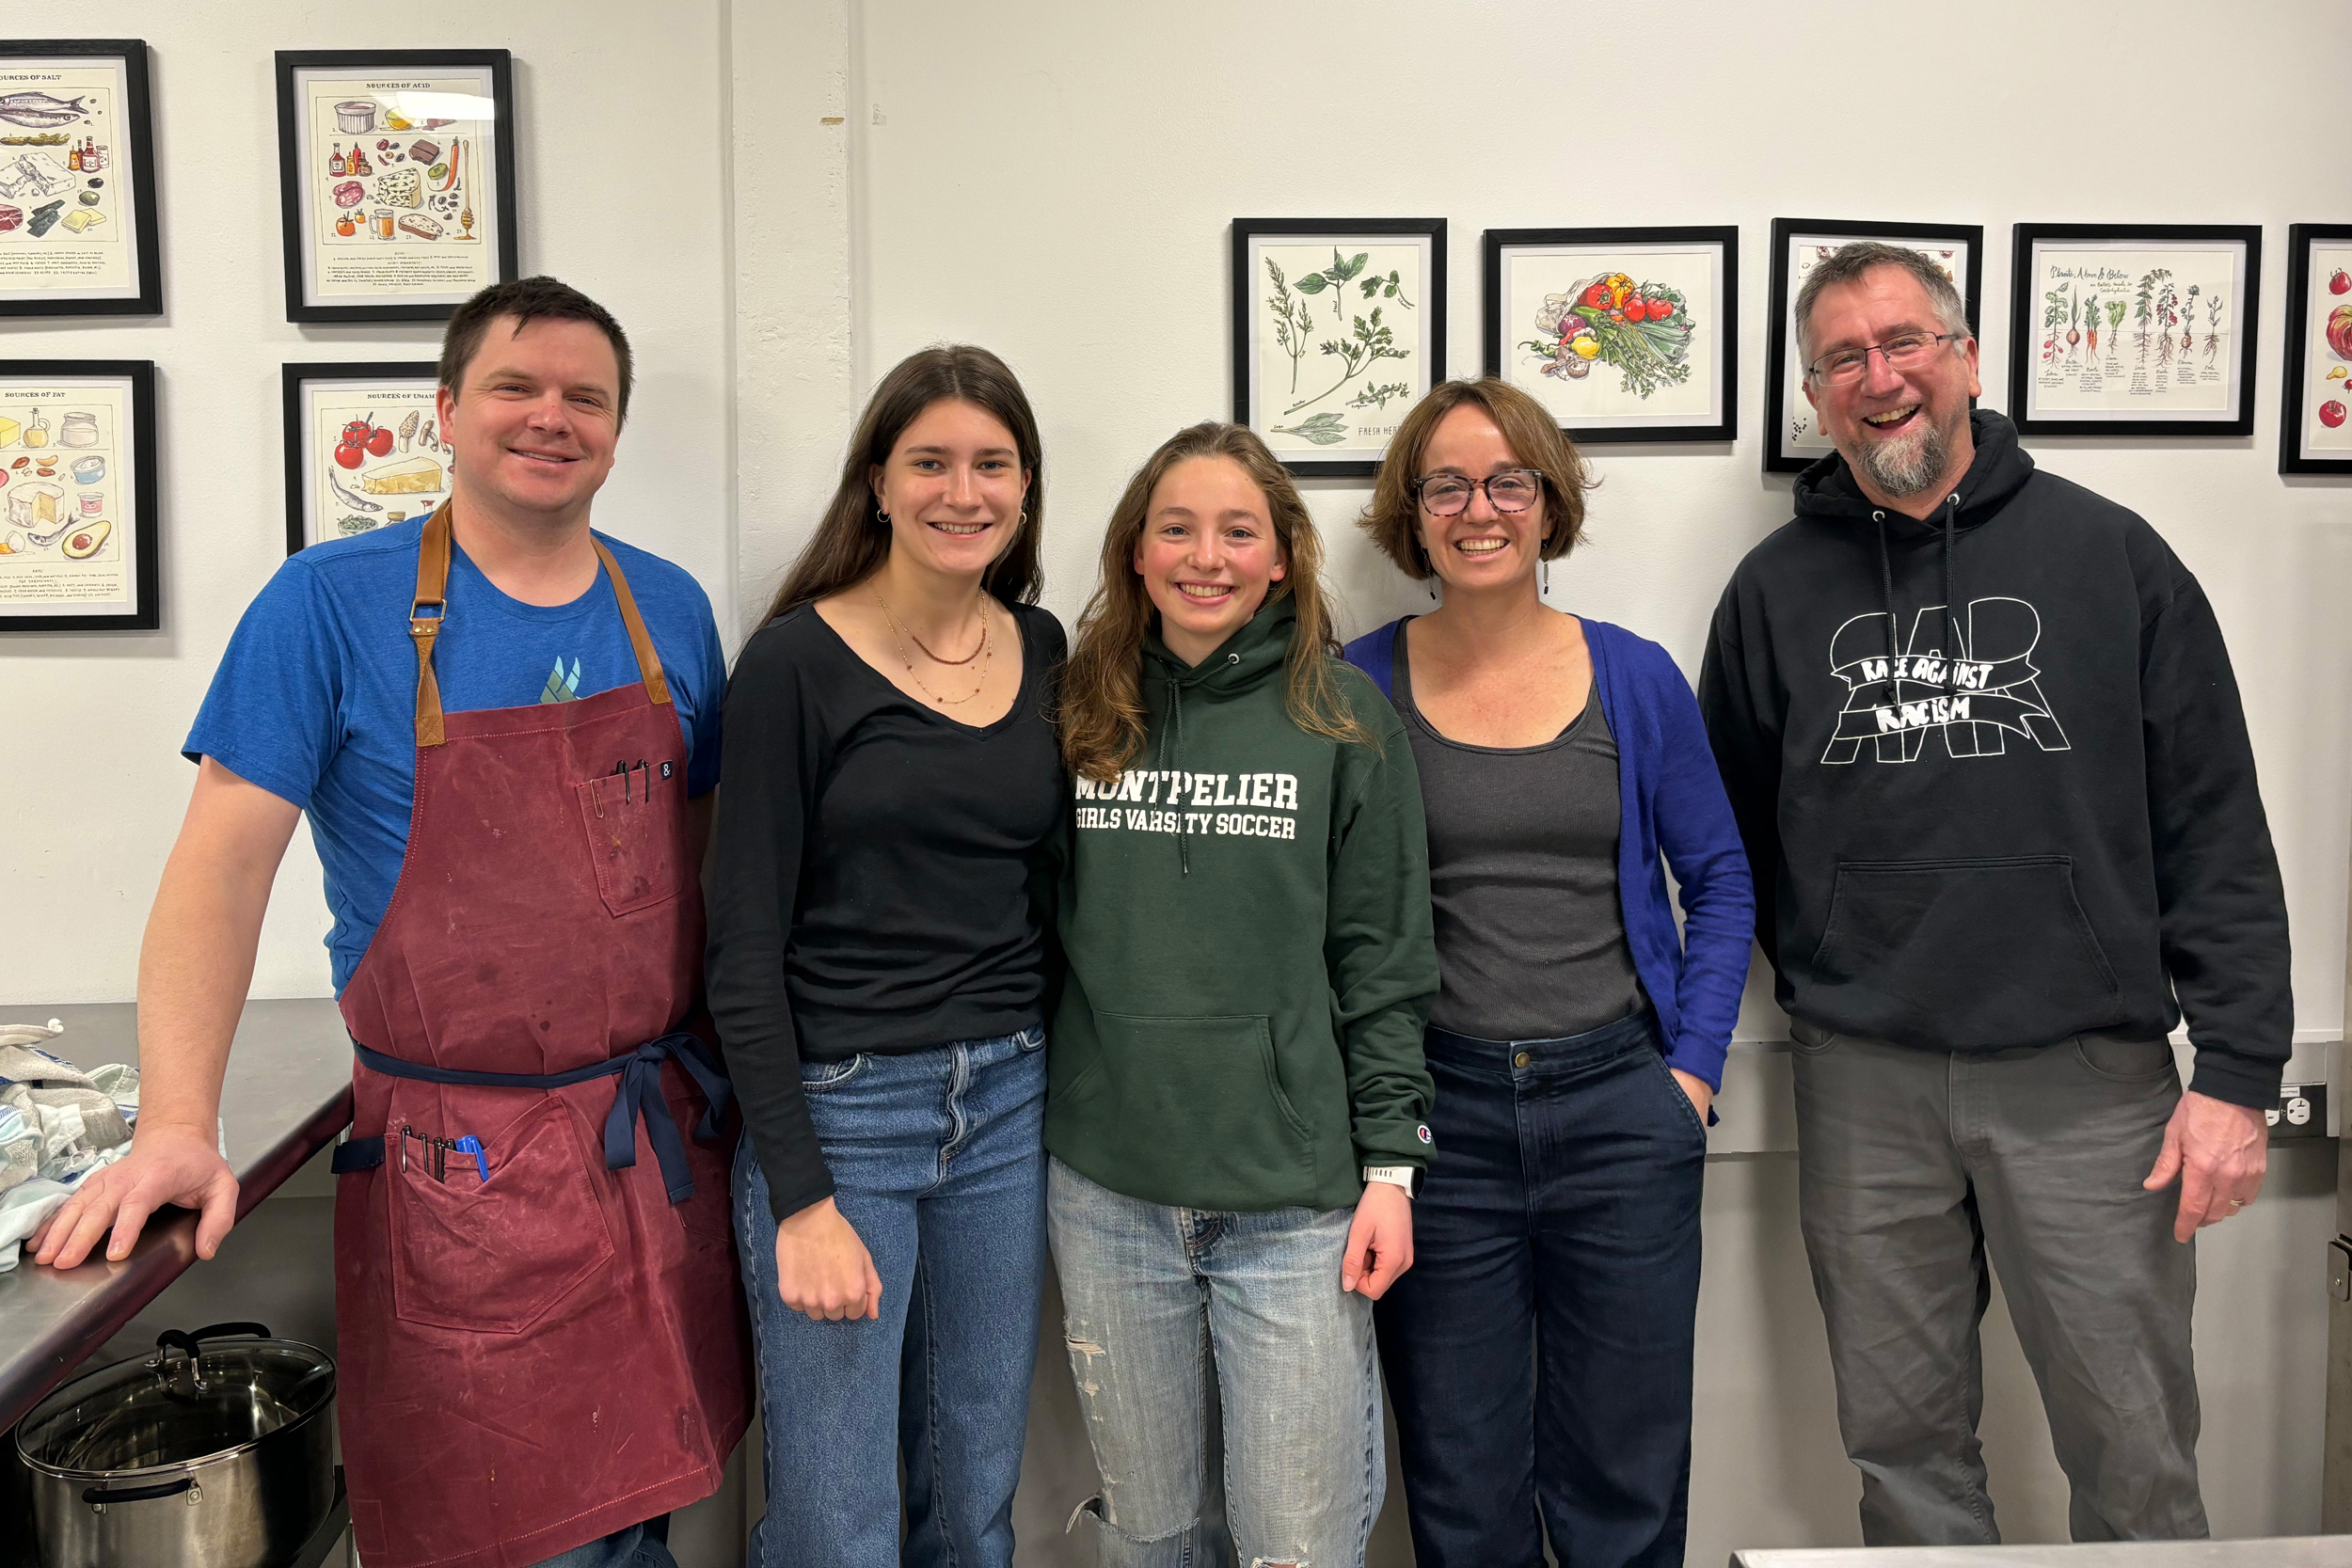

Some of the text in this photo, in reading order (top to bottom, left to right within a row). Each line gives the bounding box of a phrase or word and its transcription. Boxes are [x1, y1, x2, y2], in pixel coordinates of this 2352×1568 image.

[2077, 266, 2097, 279] Above
[2106, 268, 2129, 280] Below
[1358, 427, 1380, 436] FRESH
[1875, 695, 1970, 733] RACISM
[1075, 769, 1298, 811] MONTPELIER
[1076, 808, 1295, 840] GIRLS VARSITY SOCCER
